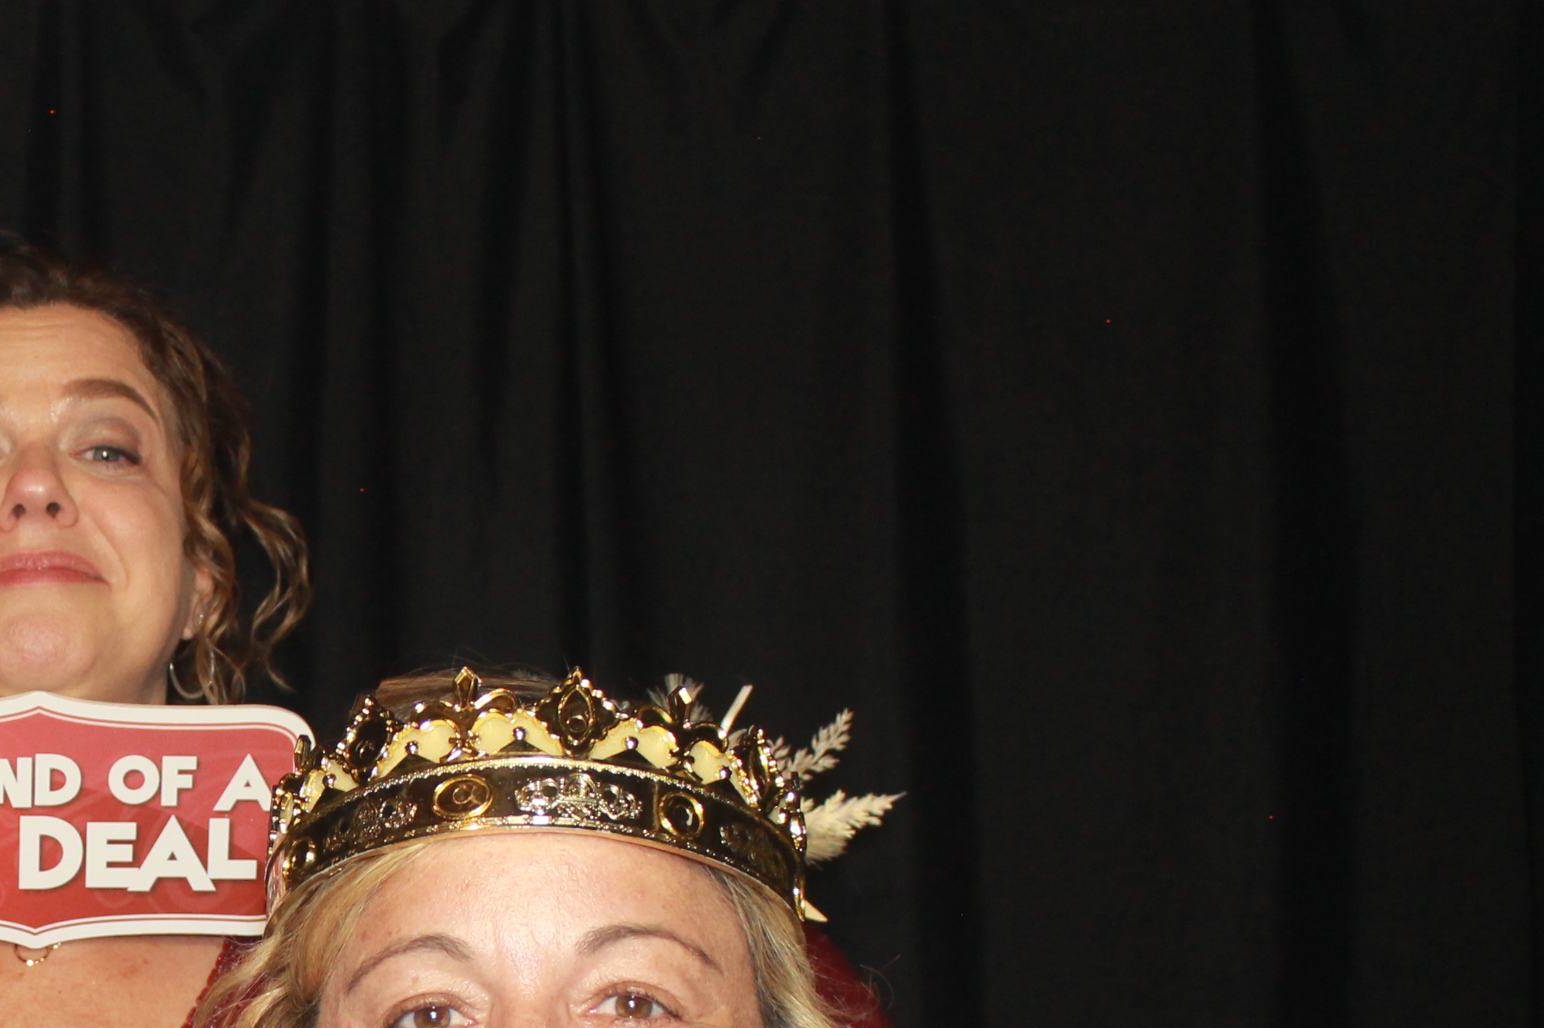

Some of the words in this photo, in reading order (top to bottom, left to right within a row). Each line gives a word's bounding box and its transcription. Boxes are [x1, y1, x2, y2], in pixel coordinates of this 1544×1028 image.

[108, 754, 198, 807] OF
[213, 753, 272, 812] A
[18, 814, 257, 892] DEAL
